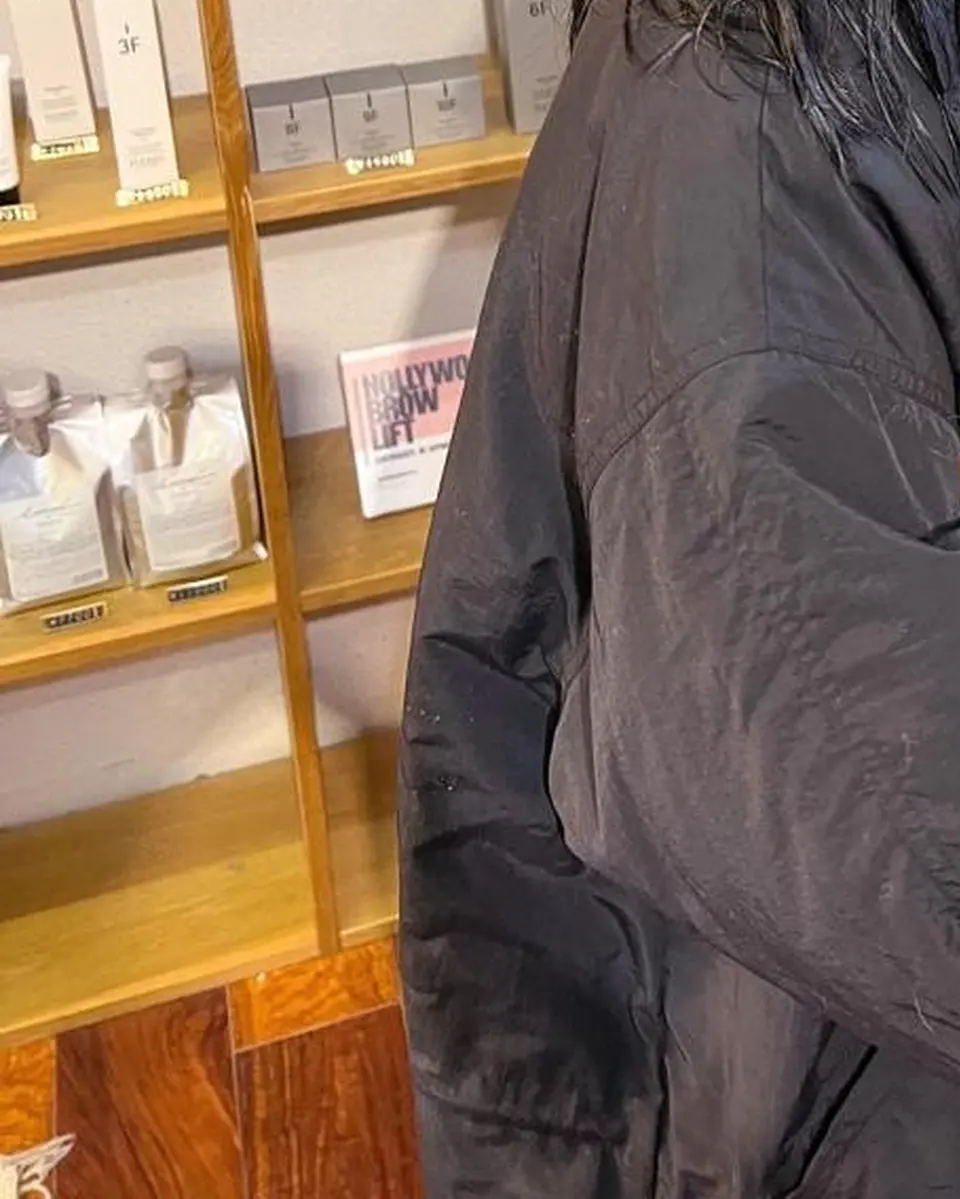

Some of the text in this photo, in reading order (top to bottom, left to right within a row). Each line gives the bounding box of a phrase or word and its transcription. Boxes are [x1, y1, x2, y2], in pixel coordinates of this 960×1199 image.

[117, 36, 141, 55] 3F
[368, 385, 438, 423] BROW
[371, 418, 415, 451] LIFT
